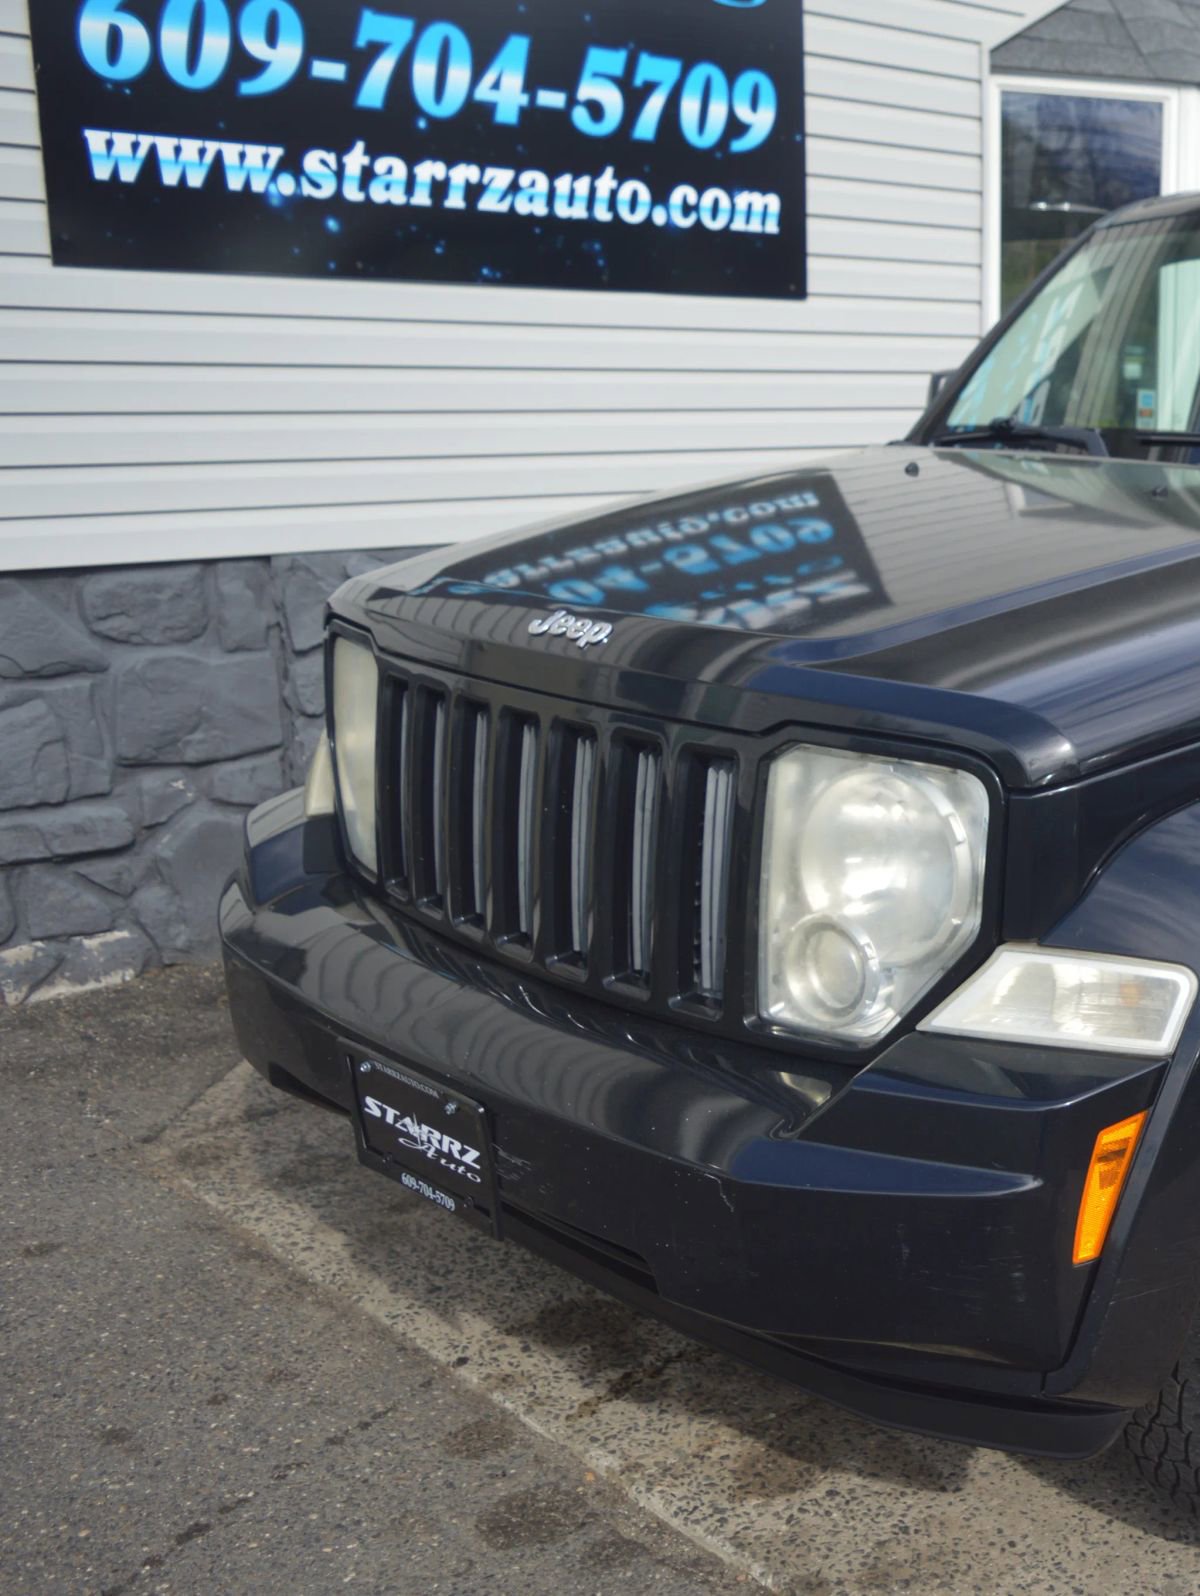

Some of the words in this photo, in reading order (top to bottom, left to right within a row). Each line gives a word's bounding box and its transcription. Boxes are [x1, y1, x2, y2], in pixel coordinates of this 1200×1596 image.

[78, 0, 778, 153] 609-704-5709
[83, 128, 780, 236] www.starrzauto.com
[528, 610, 612, 649] Jeep
[364, 1096, 480, 1169] STARRZ
[401, 1172, 456, 1212] 609-704-5709
